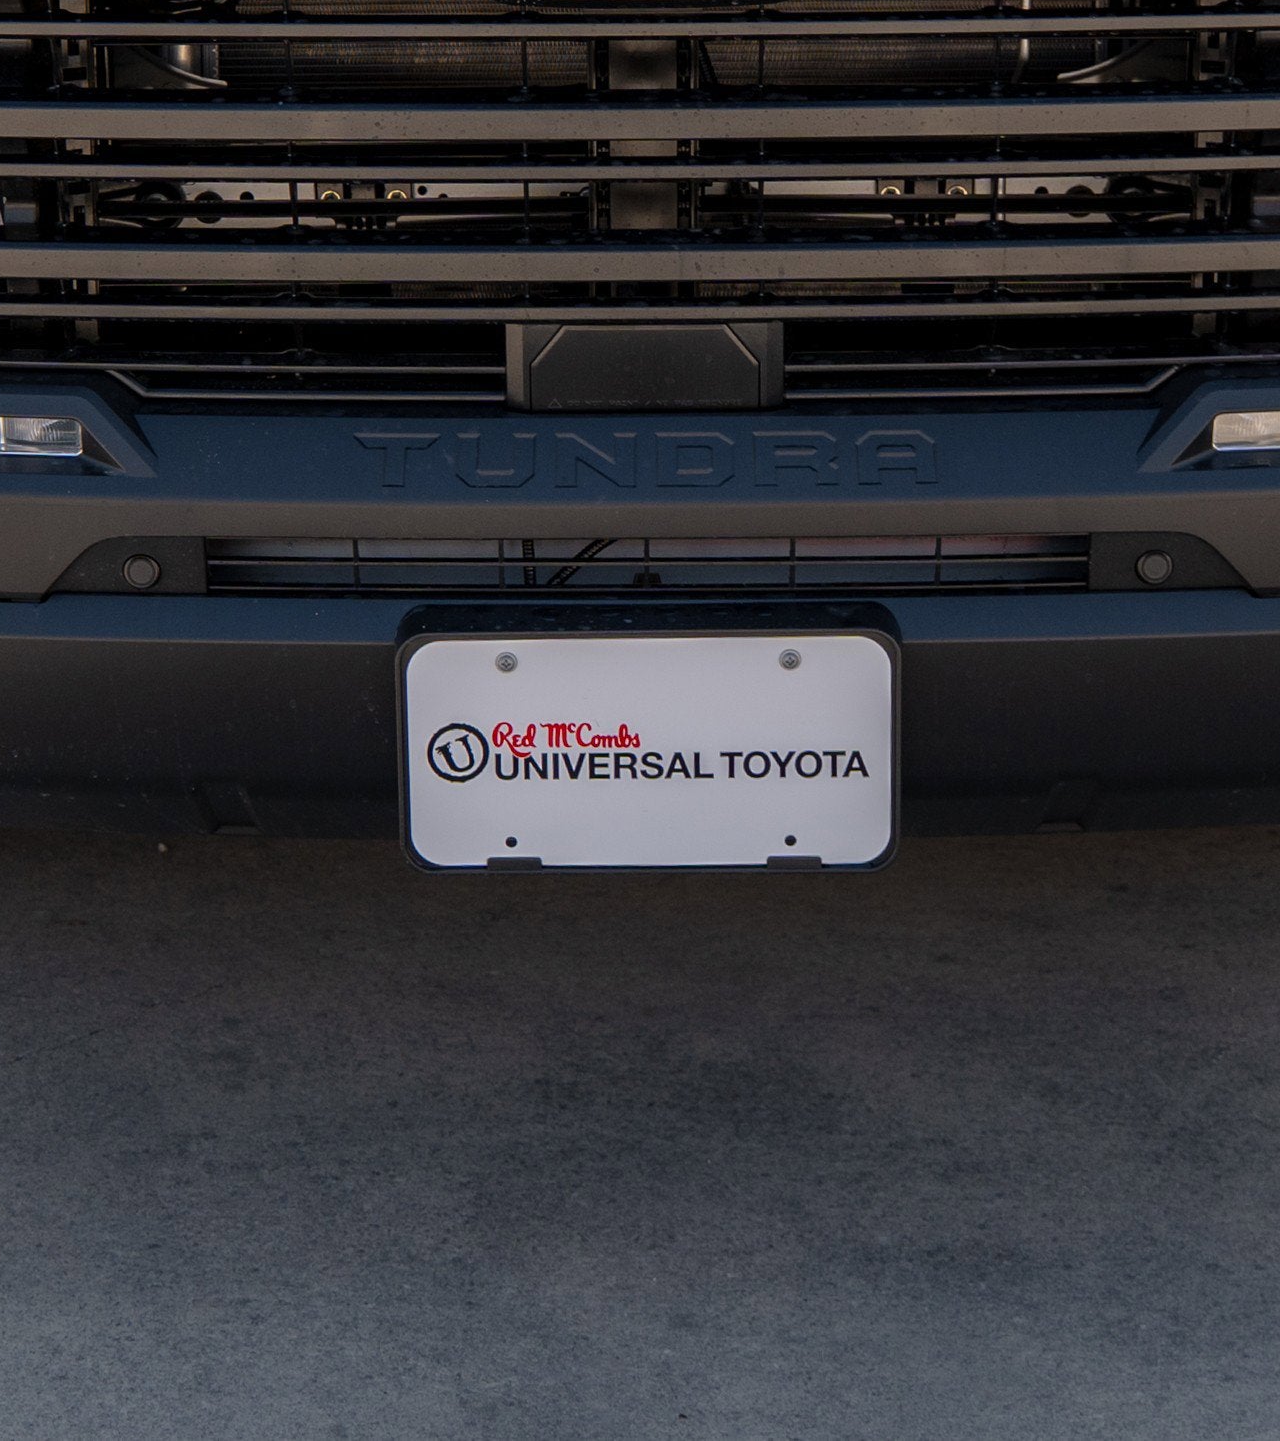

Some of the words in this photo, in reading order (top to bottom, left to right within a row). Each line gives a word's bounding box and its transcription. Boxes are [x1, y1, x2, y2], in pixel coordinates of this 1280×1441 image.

[353, 430, 939, 489] TUNDRA
[492, 722, 537, 758] Red
[540, 722, 641, 749] McCombs
[494, 751, 715, 781] UNIVERSAL
[719, 750, 870, 779] TOYOTA
